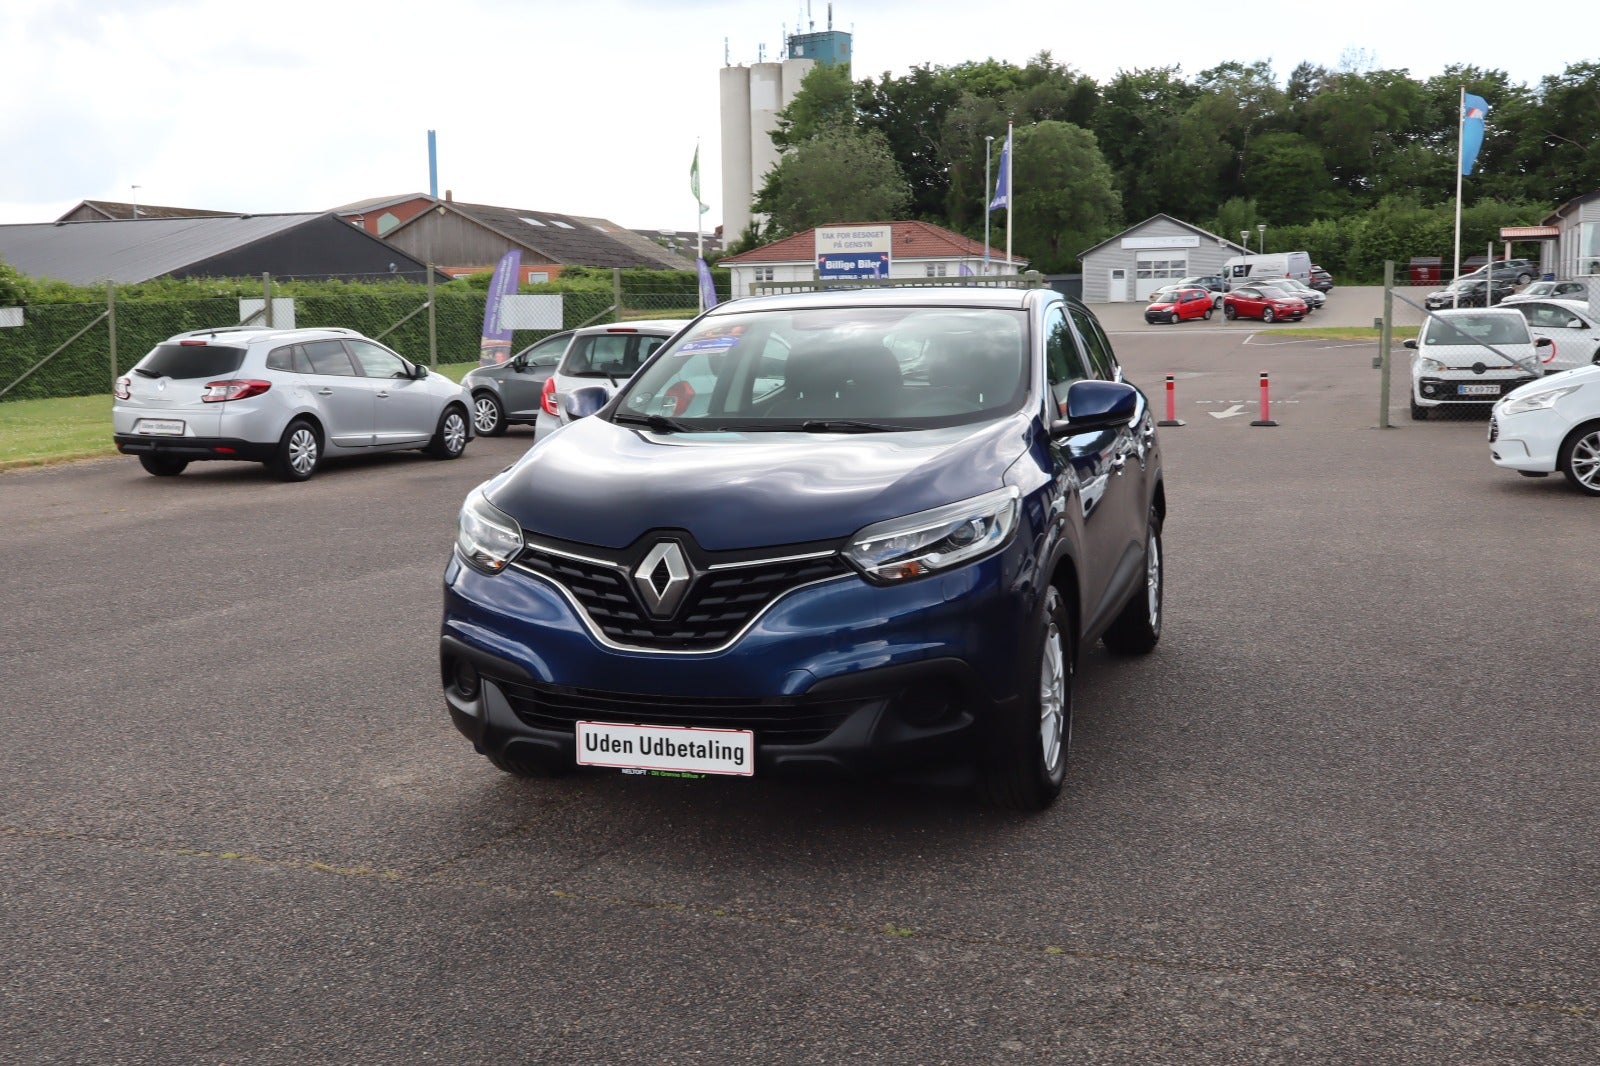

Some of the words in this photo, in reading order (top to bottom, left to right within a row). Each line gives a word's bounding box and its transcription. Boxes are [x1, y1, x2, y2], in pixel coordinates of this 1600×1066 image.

[852, 231, 884, 239] BESØGET
[833, 240, 843, 249] PÅ
[844, 241, 873, 249] GENSYN
[825, 260, 856, 271] Billige
[857, 259, 881, 269] Biler
[585, 732, 633, 754] Uden
[639, 736, 744, 765] Udbetaling
